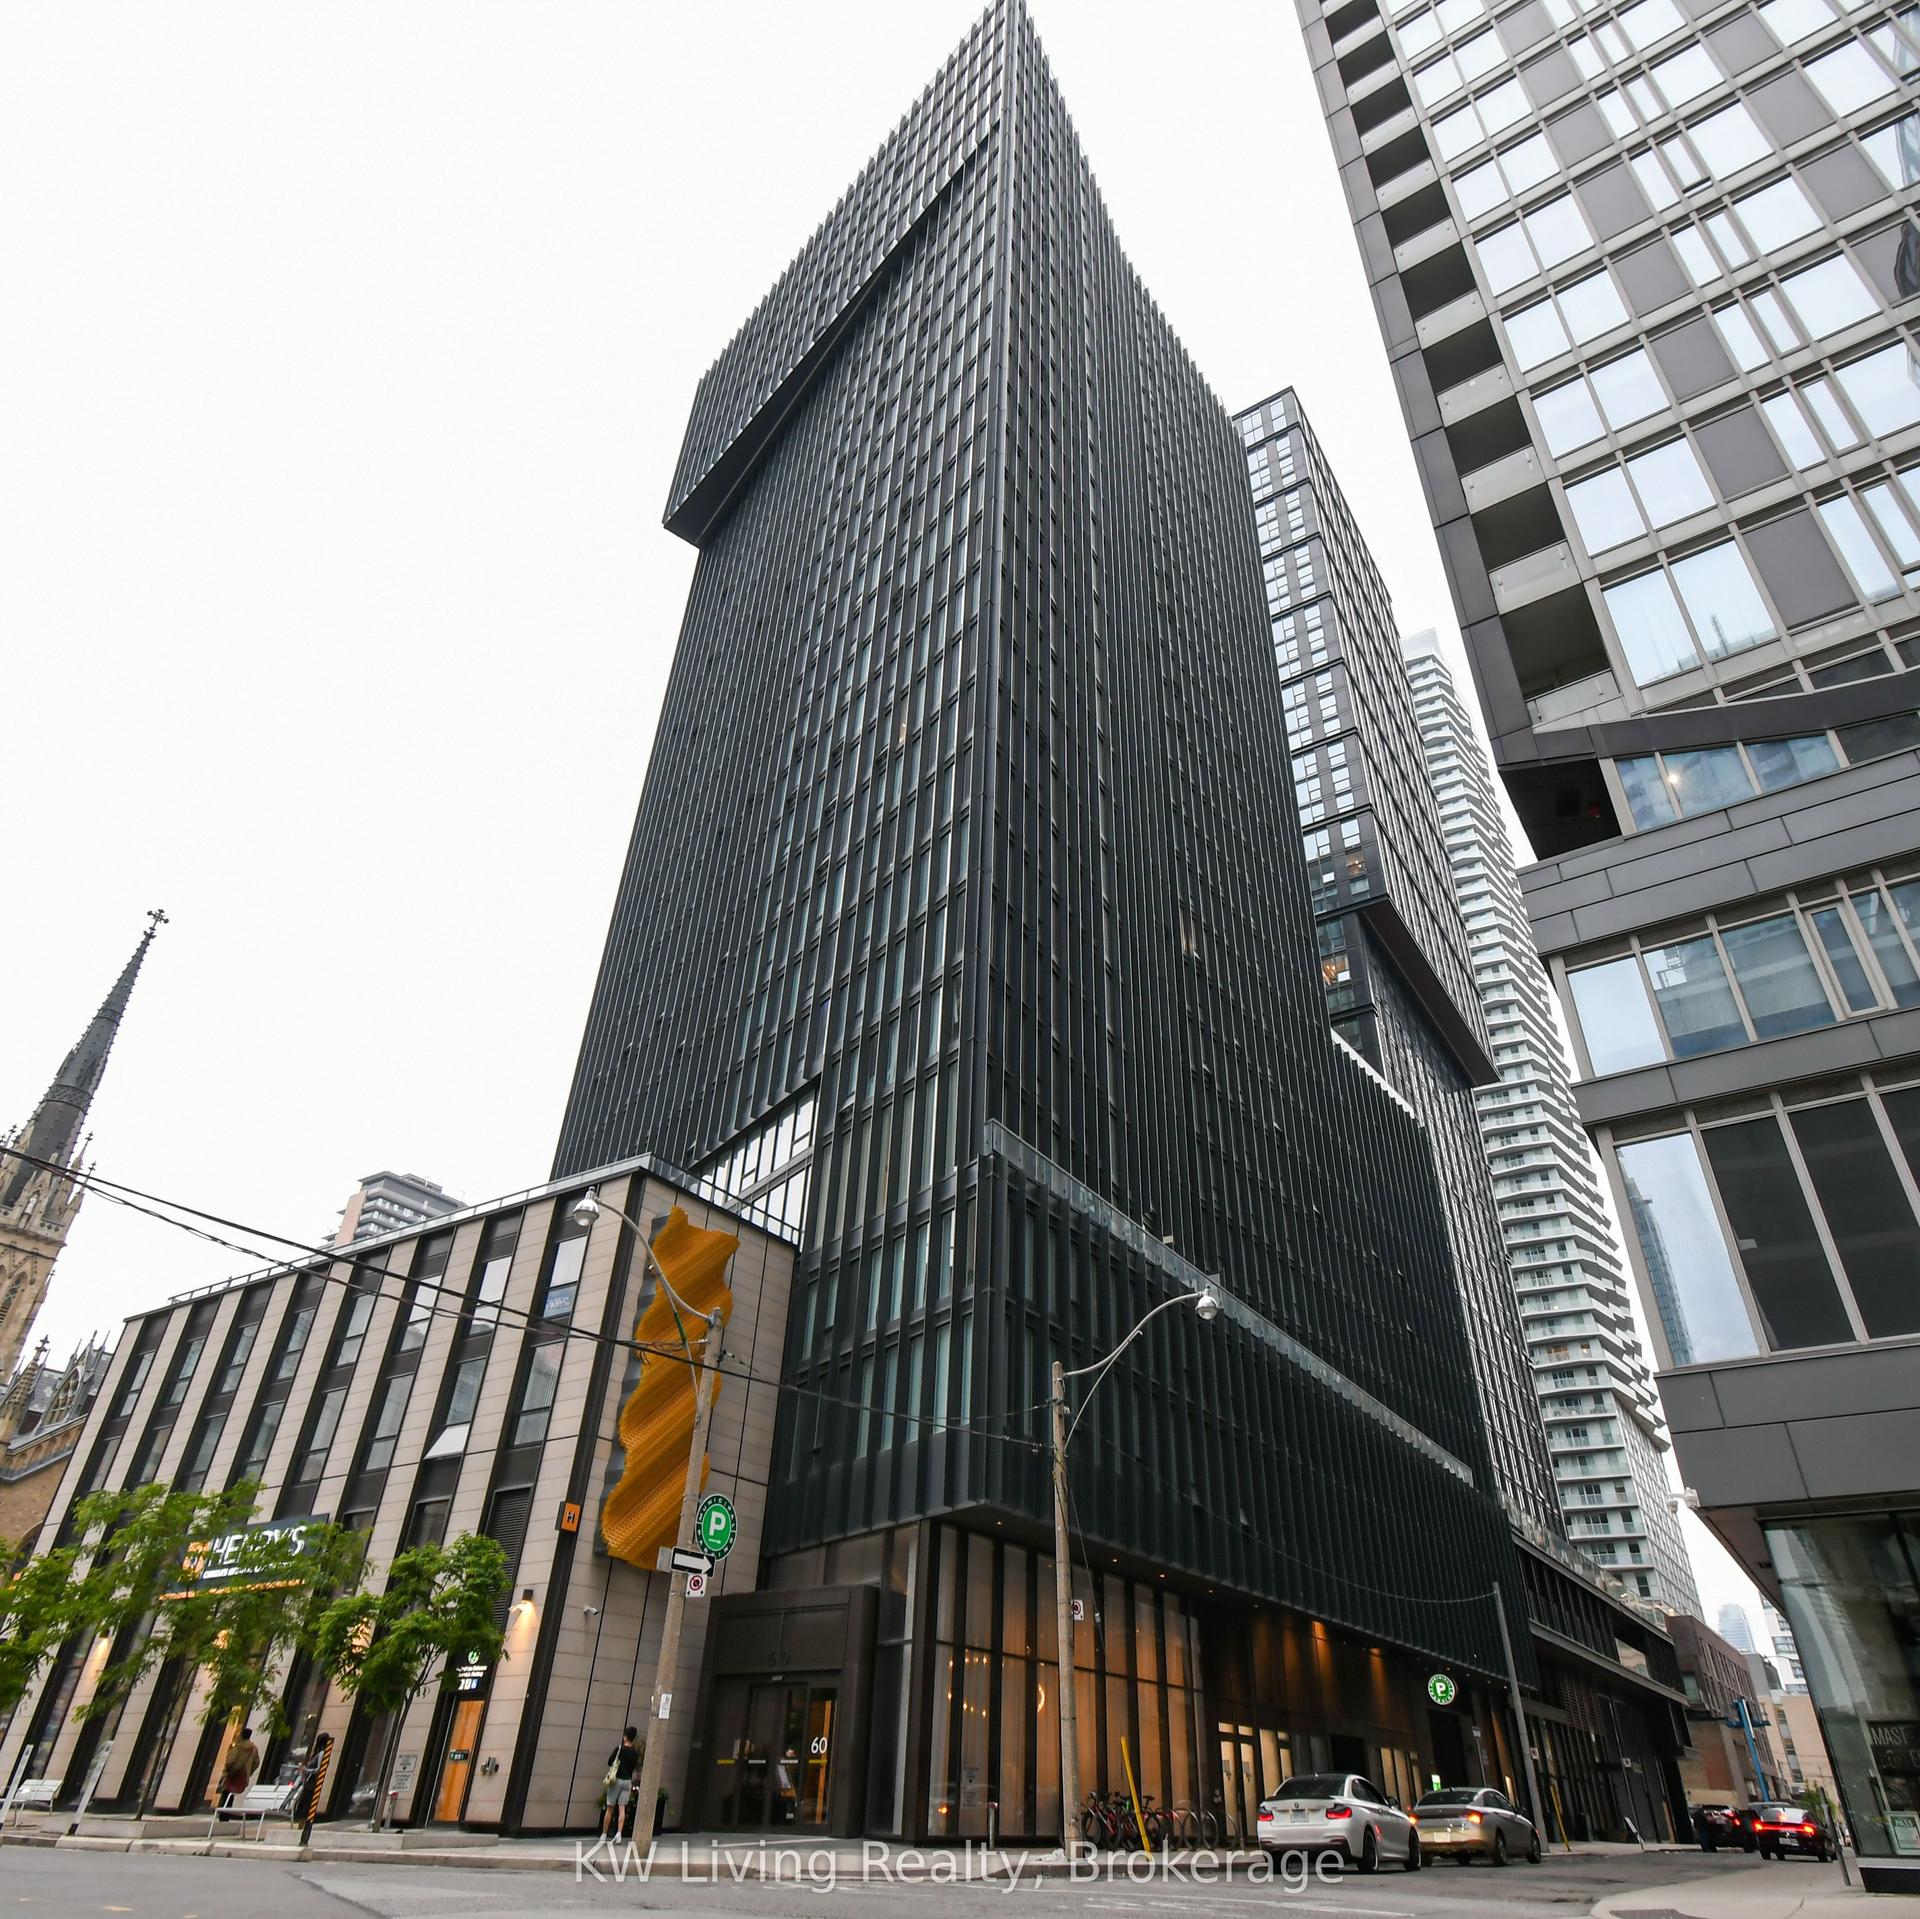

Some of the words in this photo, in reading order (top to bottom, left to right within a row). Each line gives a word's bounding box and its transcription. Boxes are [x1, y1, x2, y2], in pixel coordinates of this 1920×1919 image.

[709, 1511, 727, 1537] P
[1435, 1682, 1447, 1697] P
[811, 1737, 828, 1754] 60
